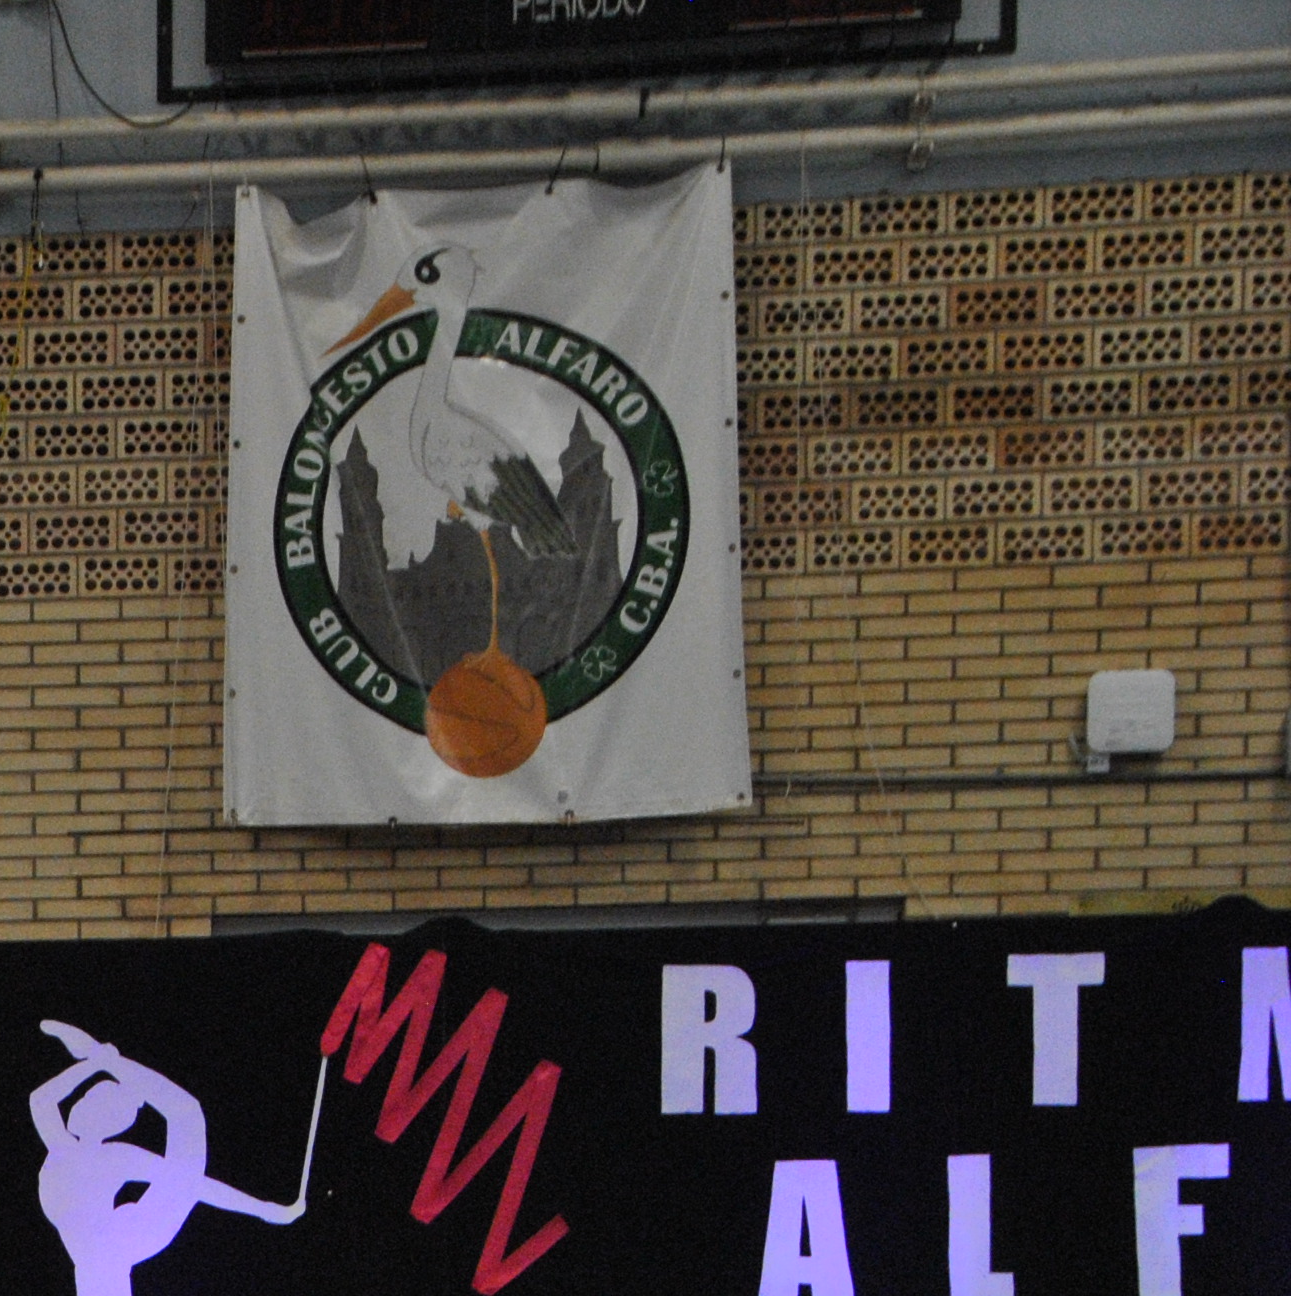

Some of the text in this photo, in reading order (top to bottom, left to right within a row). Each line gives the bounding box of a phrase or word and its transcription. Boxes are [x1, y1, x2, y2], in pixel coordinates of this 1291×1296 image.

[309, 607, 398, 704] CLUB
[494, 321, 649, 426] ALFARO
[619, 517, 679, 634] C.B.A.
